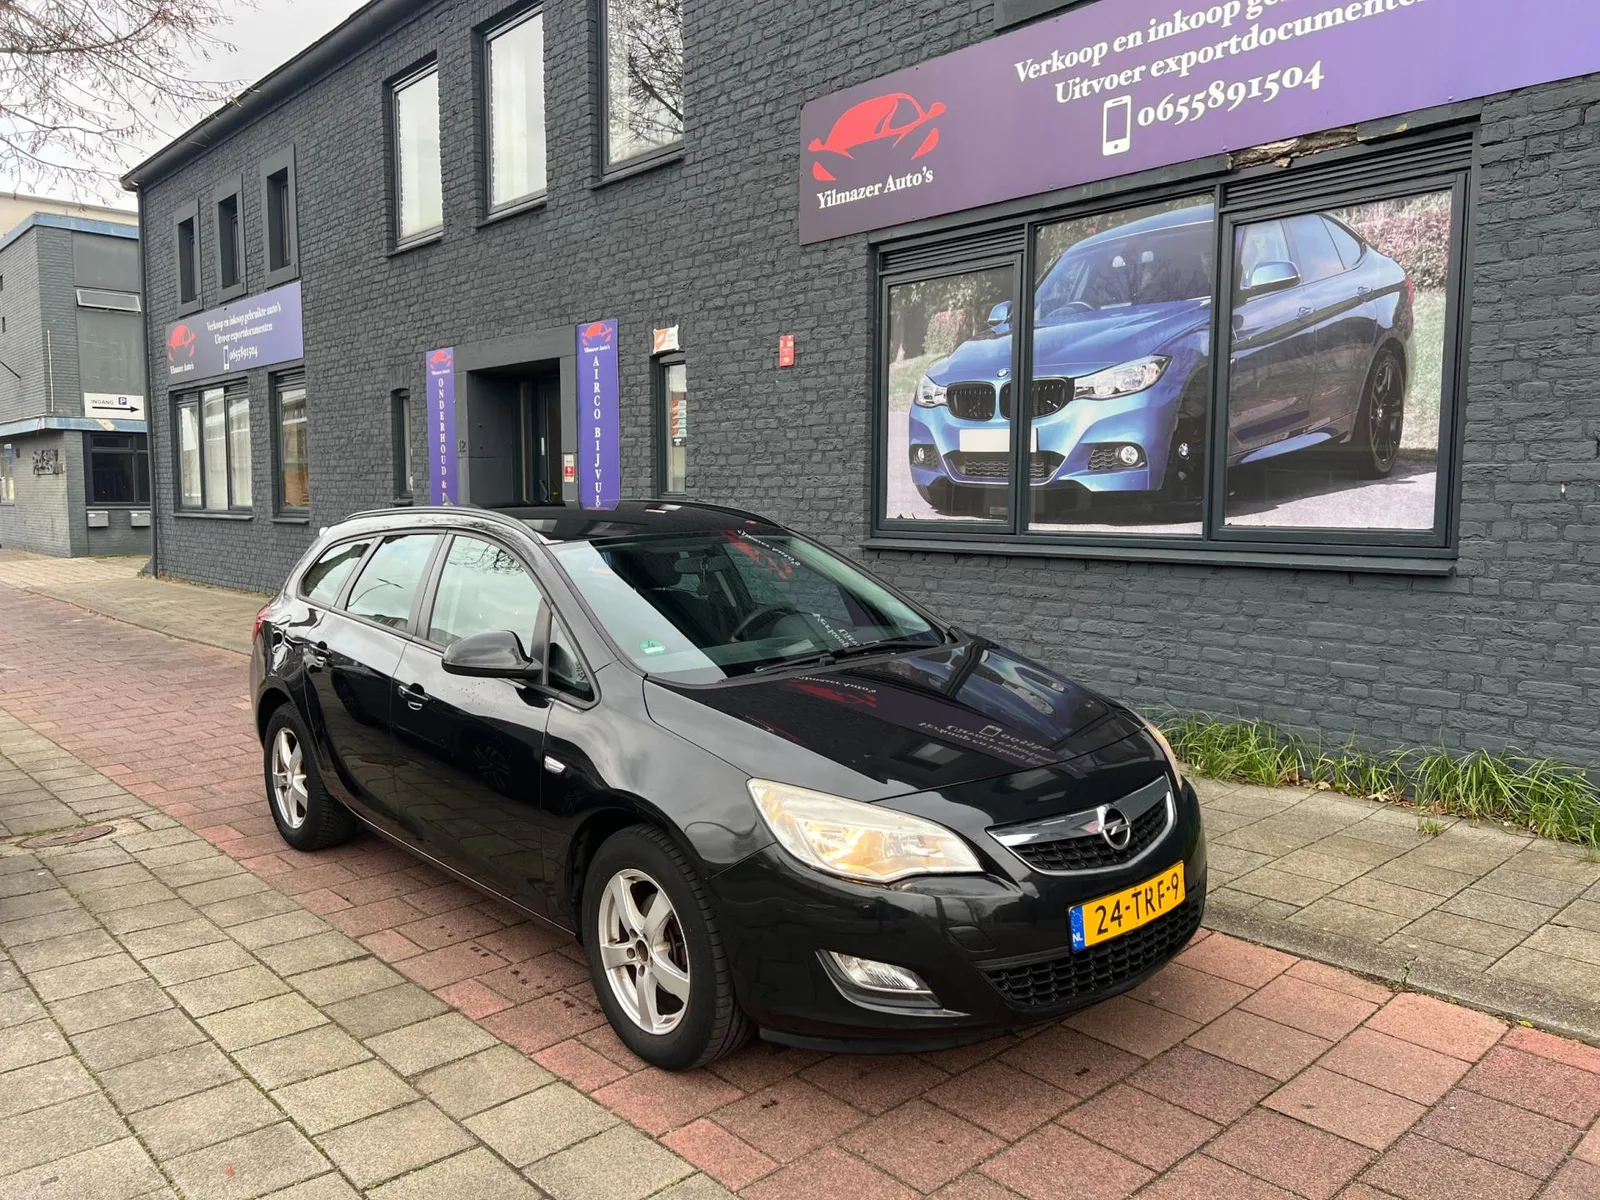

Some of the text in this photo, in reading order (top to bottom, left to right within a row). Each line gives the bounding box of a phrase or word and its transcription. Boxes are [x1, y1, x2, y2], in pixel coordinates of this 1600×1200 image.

[1014, 41, 1108, 83] Verkoop
[1113, 30, 1143, 52] en
[1147, 0, 1241, 43] inkoop
[1055, 0, 1426, 104] Uitvoer exportdocument
[1137, 60, 1325, 127] 0655891504
[816, 165, 934, 209] Yilmazer Auto's
[592, 355, 602, 420] AIRCO
[438, 378, 447, 476] ONDERHOUD
[1095, 872, 1180, 936] 24-TRF-9
[1071, 932, 1084, 944] NL
